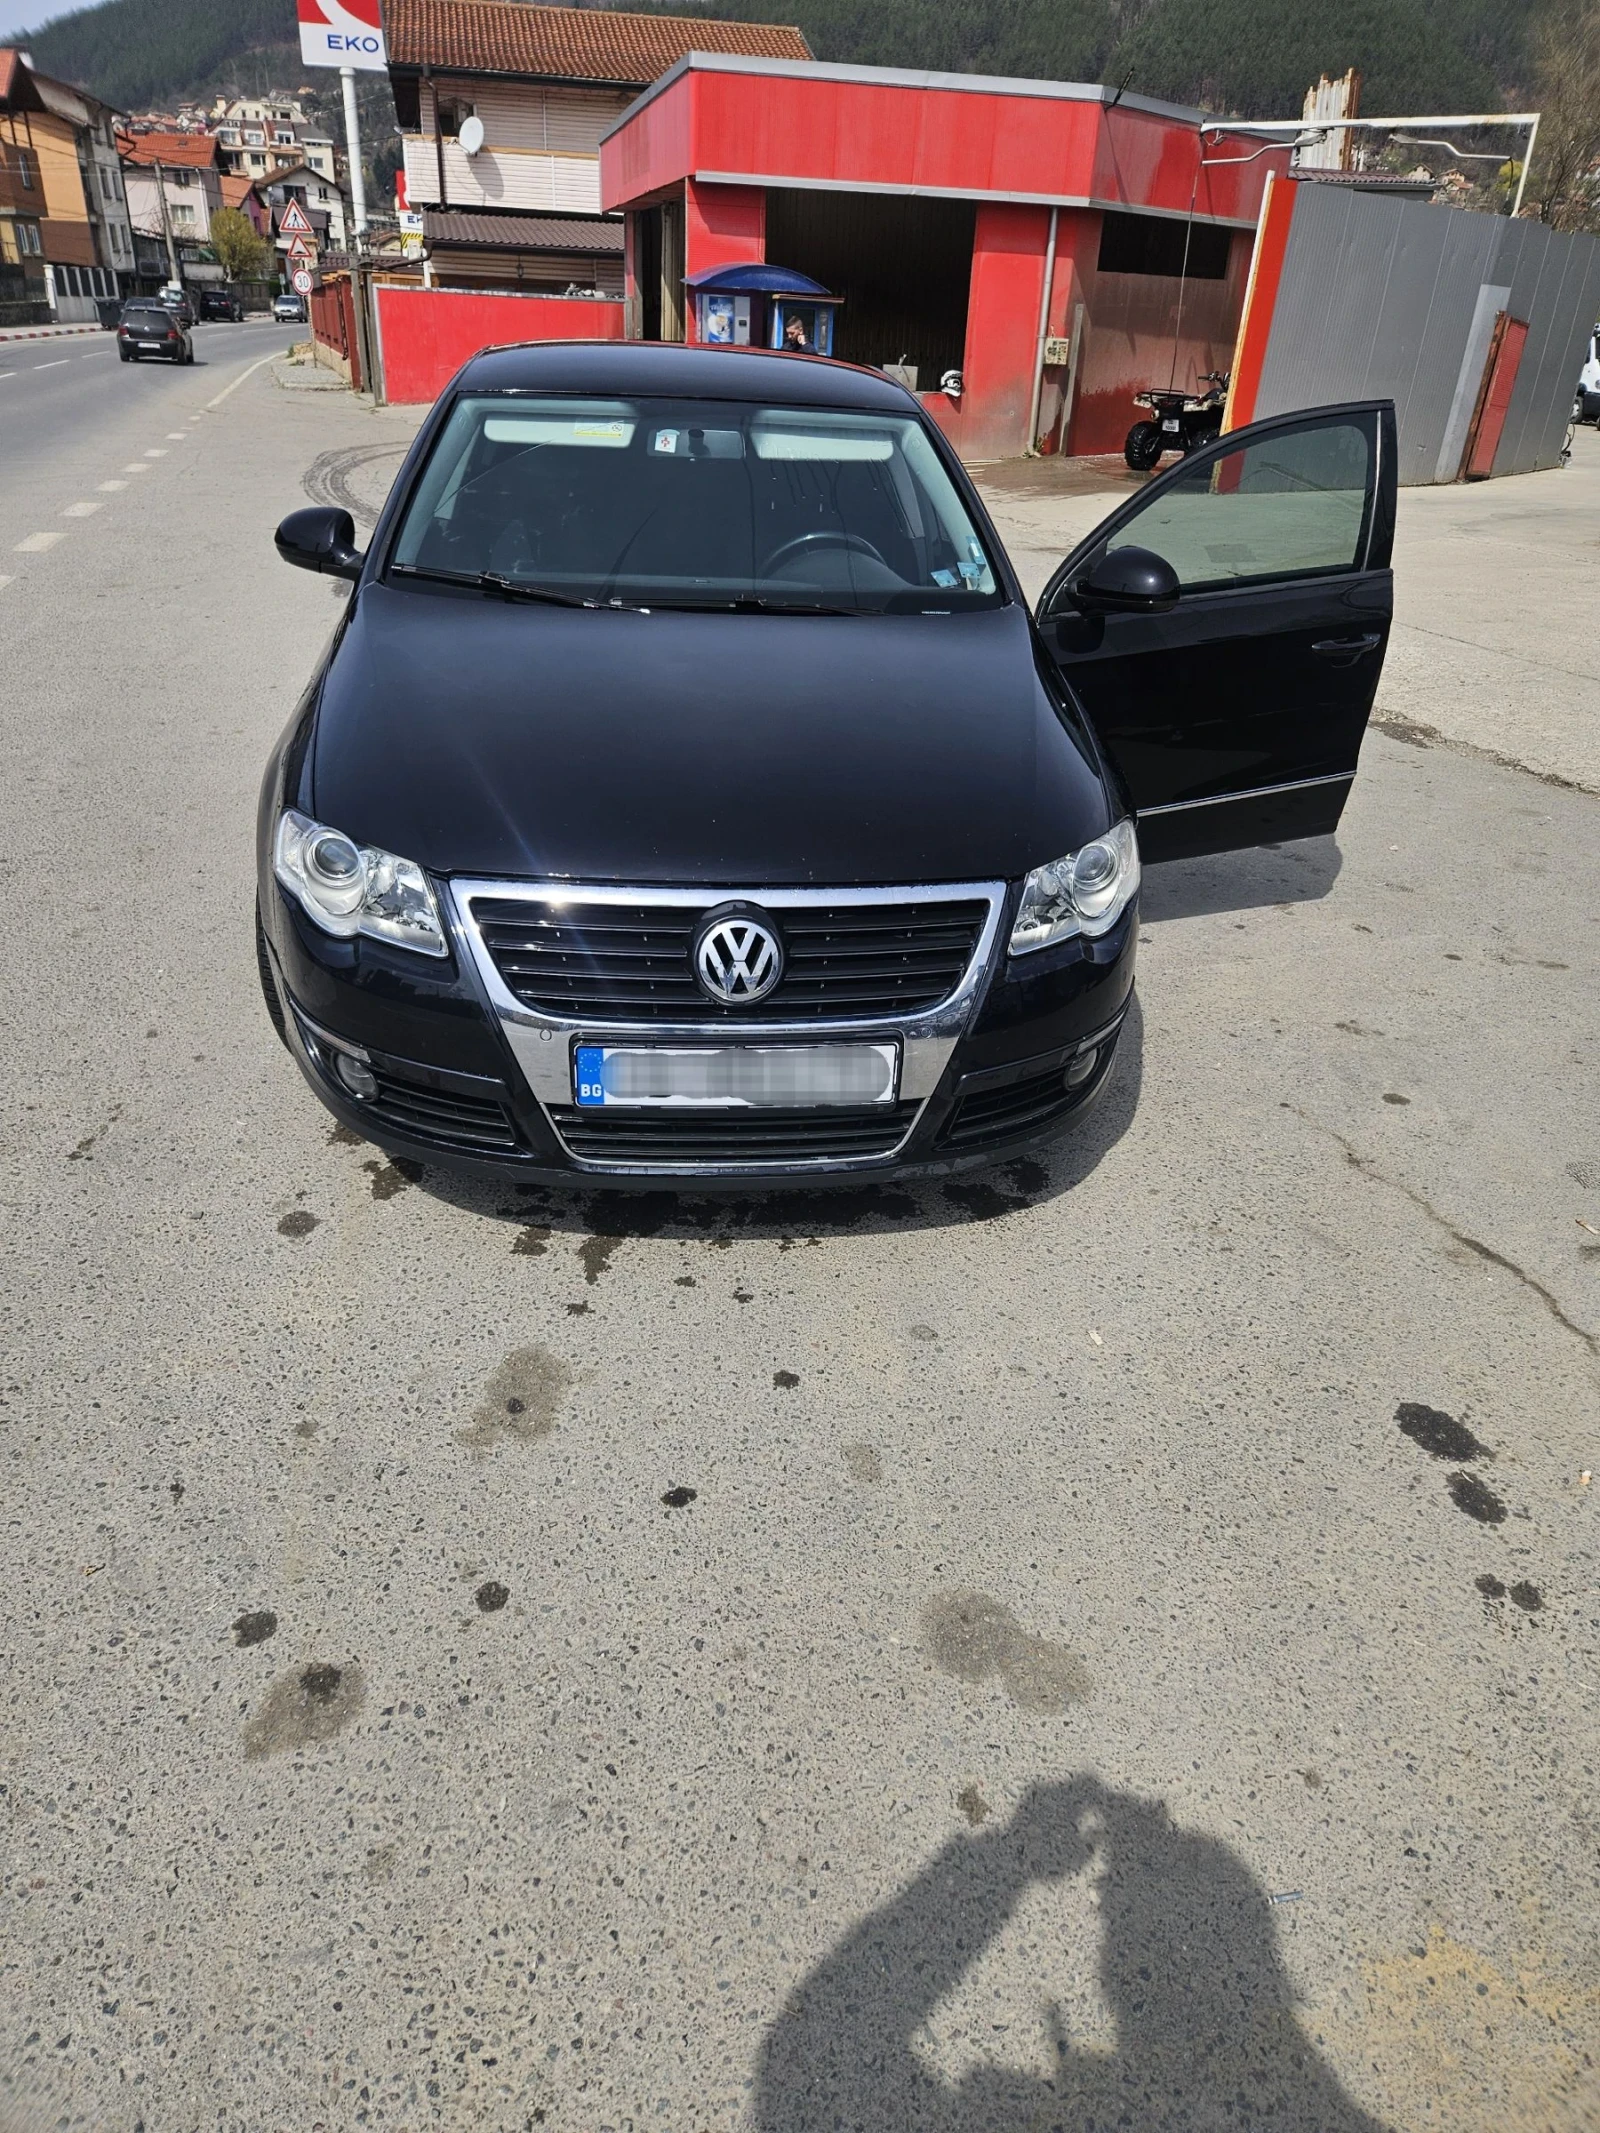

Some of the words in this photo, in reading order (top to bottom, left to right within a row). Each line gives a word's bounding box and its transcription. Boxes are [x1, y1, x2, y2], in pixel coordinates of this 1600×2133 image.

[327, 34, 379, 53] EKO
[296, 275, 309, 288] 30
[700, 921, 778, 1001] VW
[580, 1083, 602, 1097] BG
